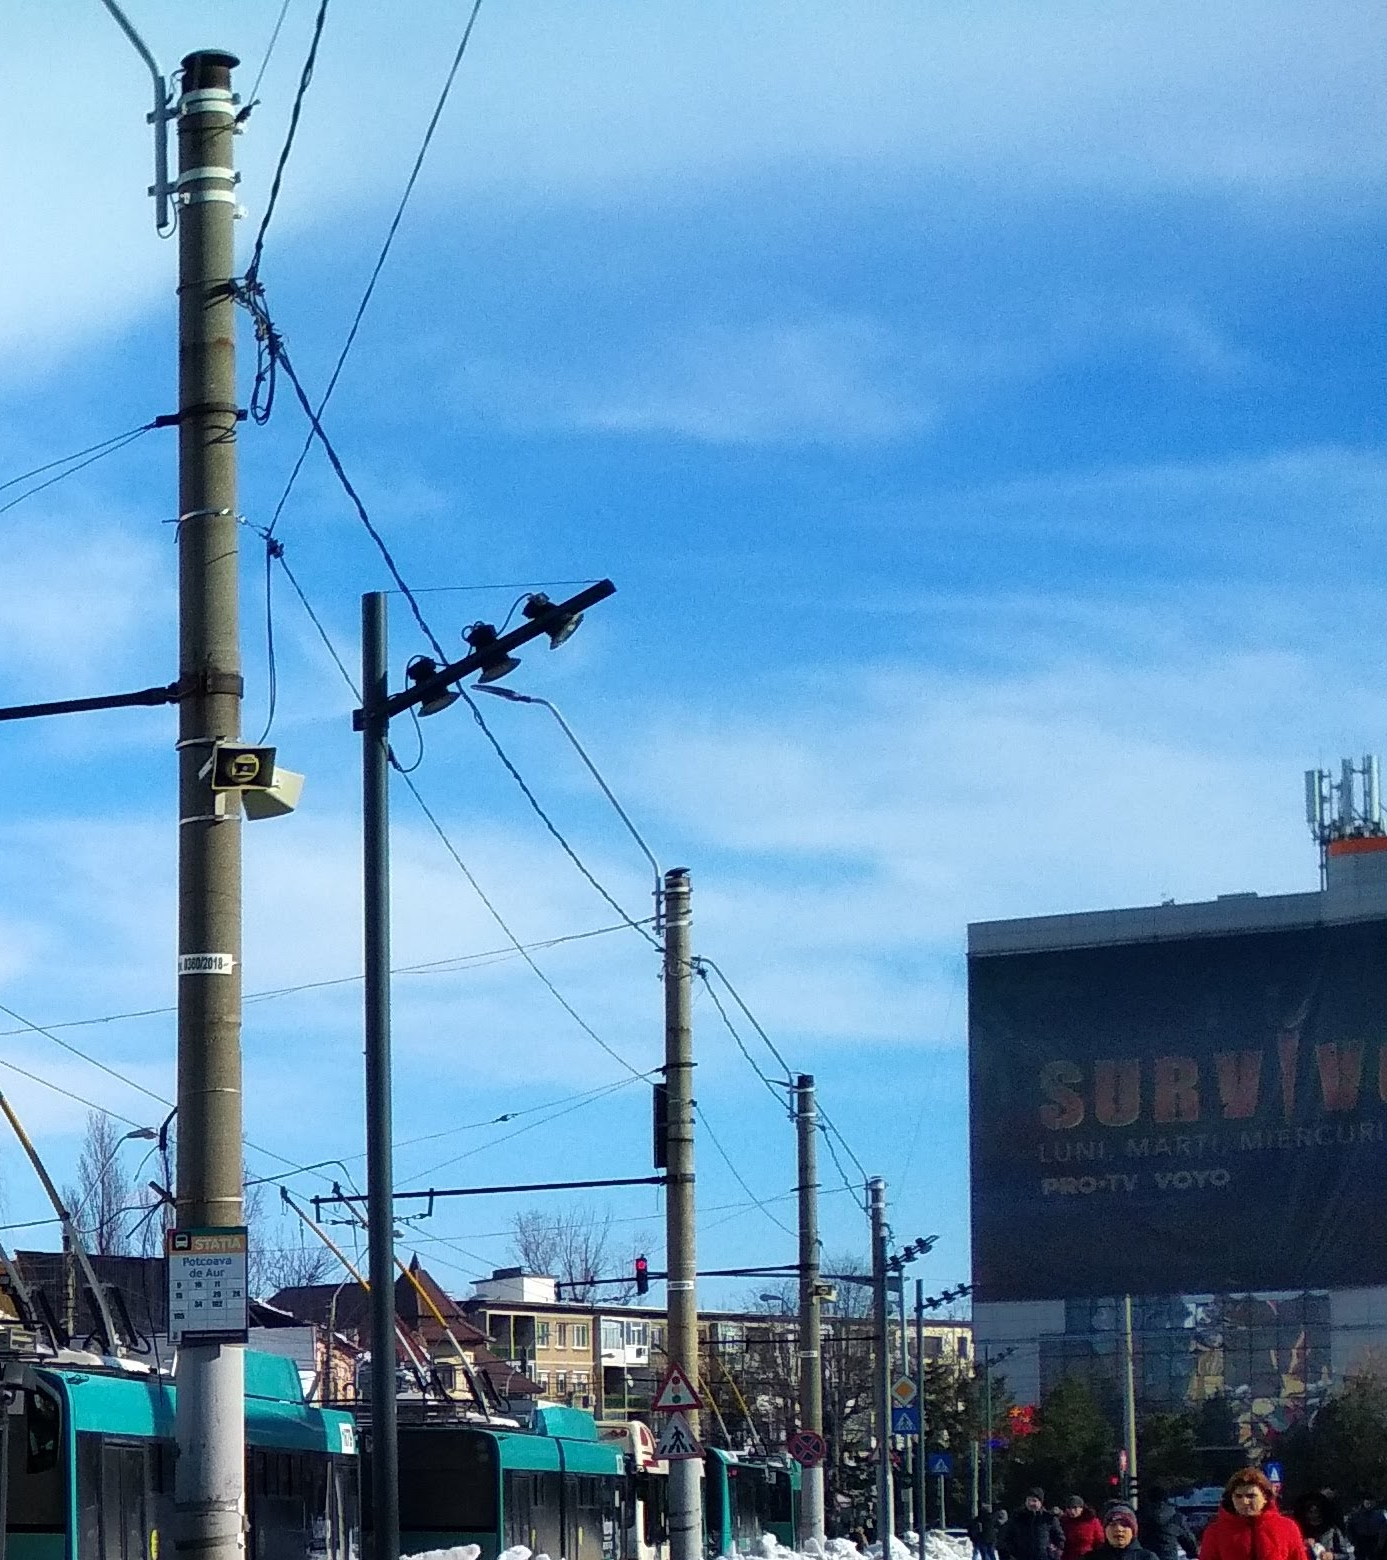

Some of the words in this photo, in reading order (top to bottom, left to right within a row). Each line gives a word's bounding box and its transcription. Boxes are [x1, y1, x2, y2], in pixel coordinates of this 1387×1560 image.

[1038, 1030, 1387, 1130] SURVIV
[1154, 1169, 1231, 1190] VOYO
[182, 1257, 233, 1267] Potcoava
[189, 1269, 203, 1278] de
[206, 1268, 225, 1277] Aur
